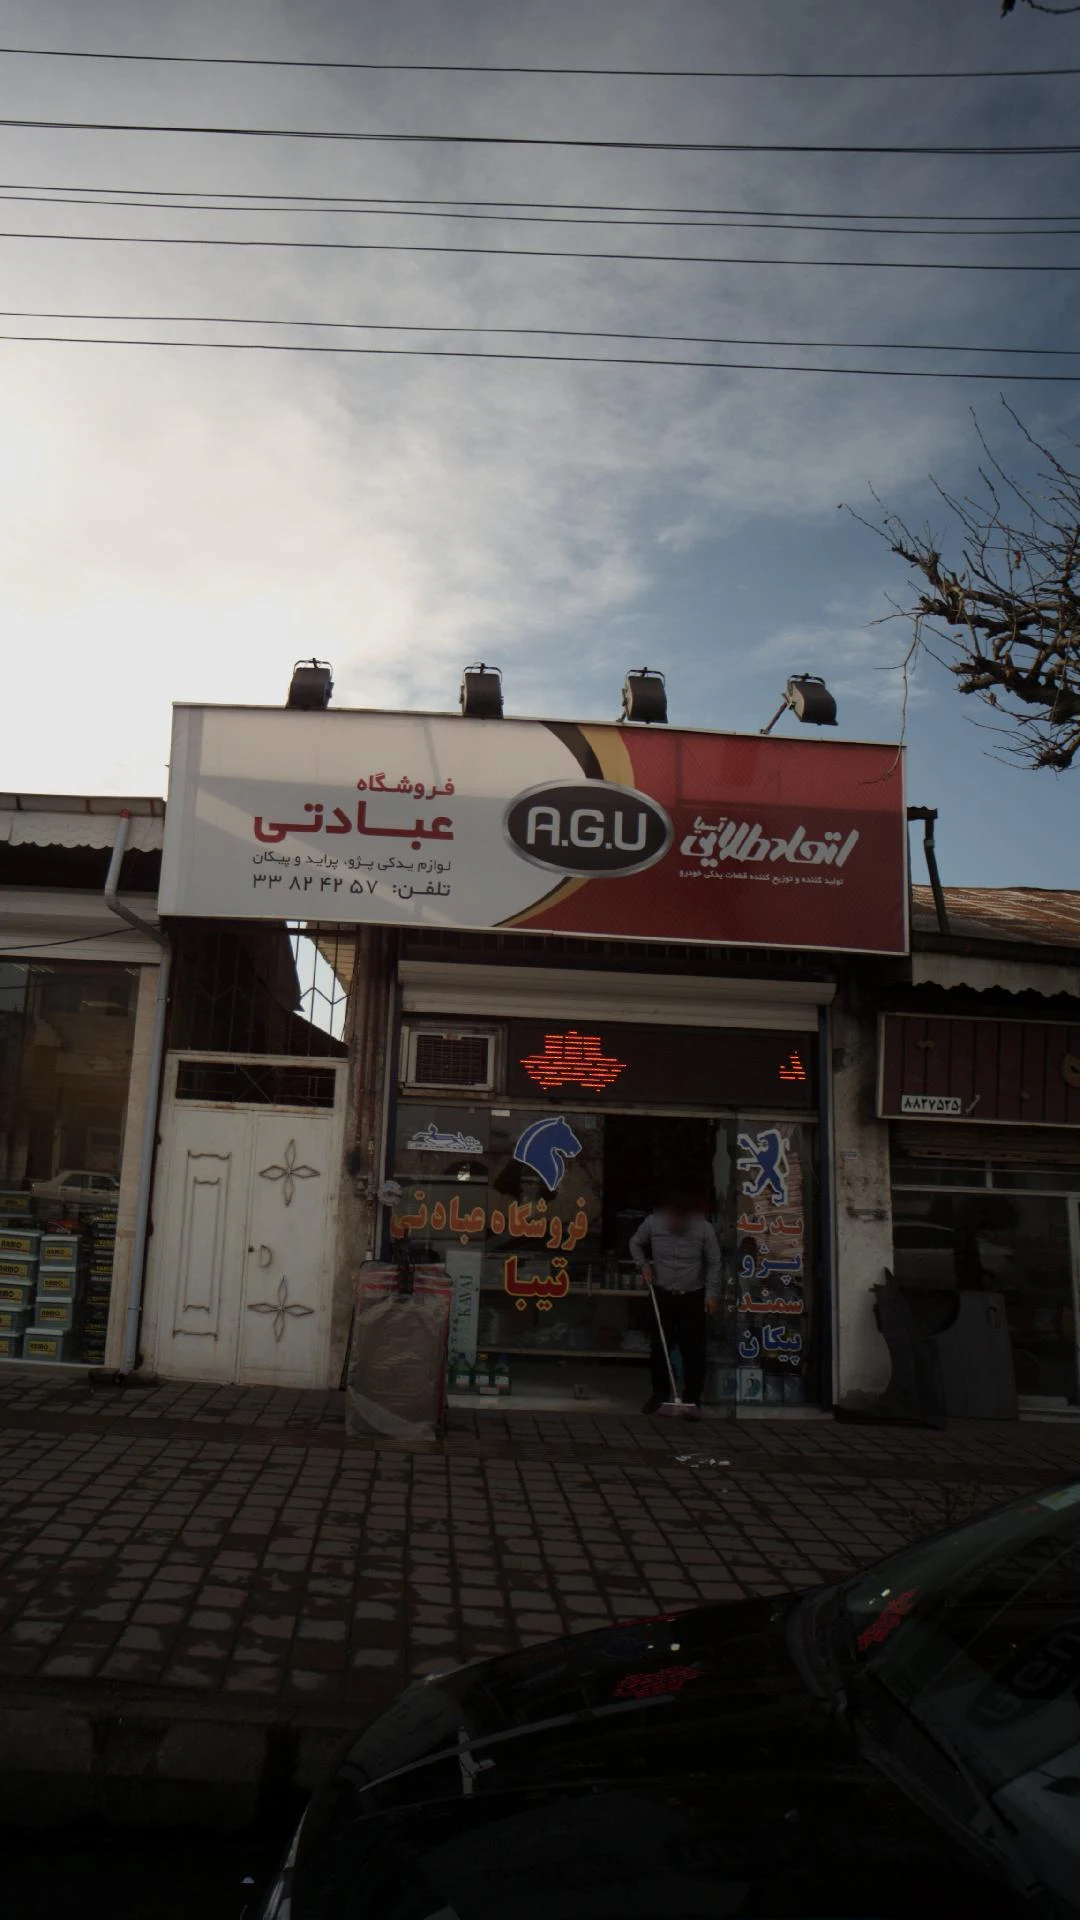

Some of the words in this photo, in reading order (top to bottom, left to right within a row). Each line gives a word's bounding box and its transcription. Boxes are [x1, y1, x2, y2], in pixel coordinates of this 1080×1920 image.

[357, 772, 455, 800] فروشگاه
[254, 800, 454, 851] عبادتی
[526, 805, 648, 851] A.G.U
[252, 851, 291, 867] پیکان
[294, 855, 301, 867] و
[306, 854, 339, 870] پراید
[378, 857, 413, 872] یدکی
[418, 858, 451, 874] لوازم
[253, 874, 282, 889] ۳۳
[289, 876, 313, 891] ۸۲
[320, 877, 343, 892] ۴۲
[350, 879, 378, 894] ۵۷
[393, 880, 451, 900] تلفن:
[390, 1190, 486, 1245] عبادتی
[491, 1197, 588, 1250] فروشگاه
[737, 1245, 802, 1286] پژو
[504, 1256, 571, 1311] تیبا
[737, 1289, 805, 1314] سمند
[738, 1324, 802, 1366] پیکان
